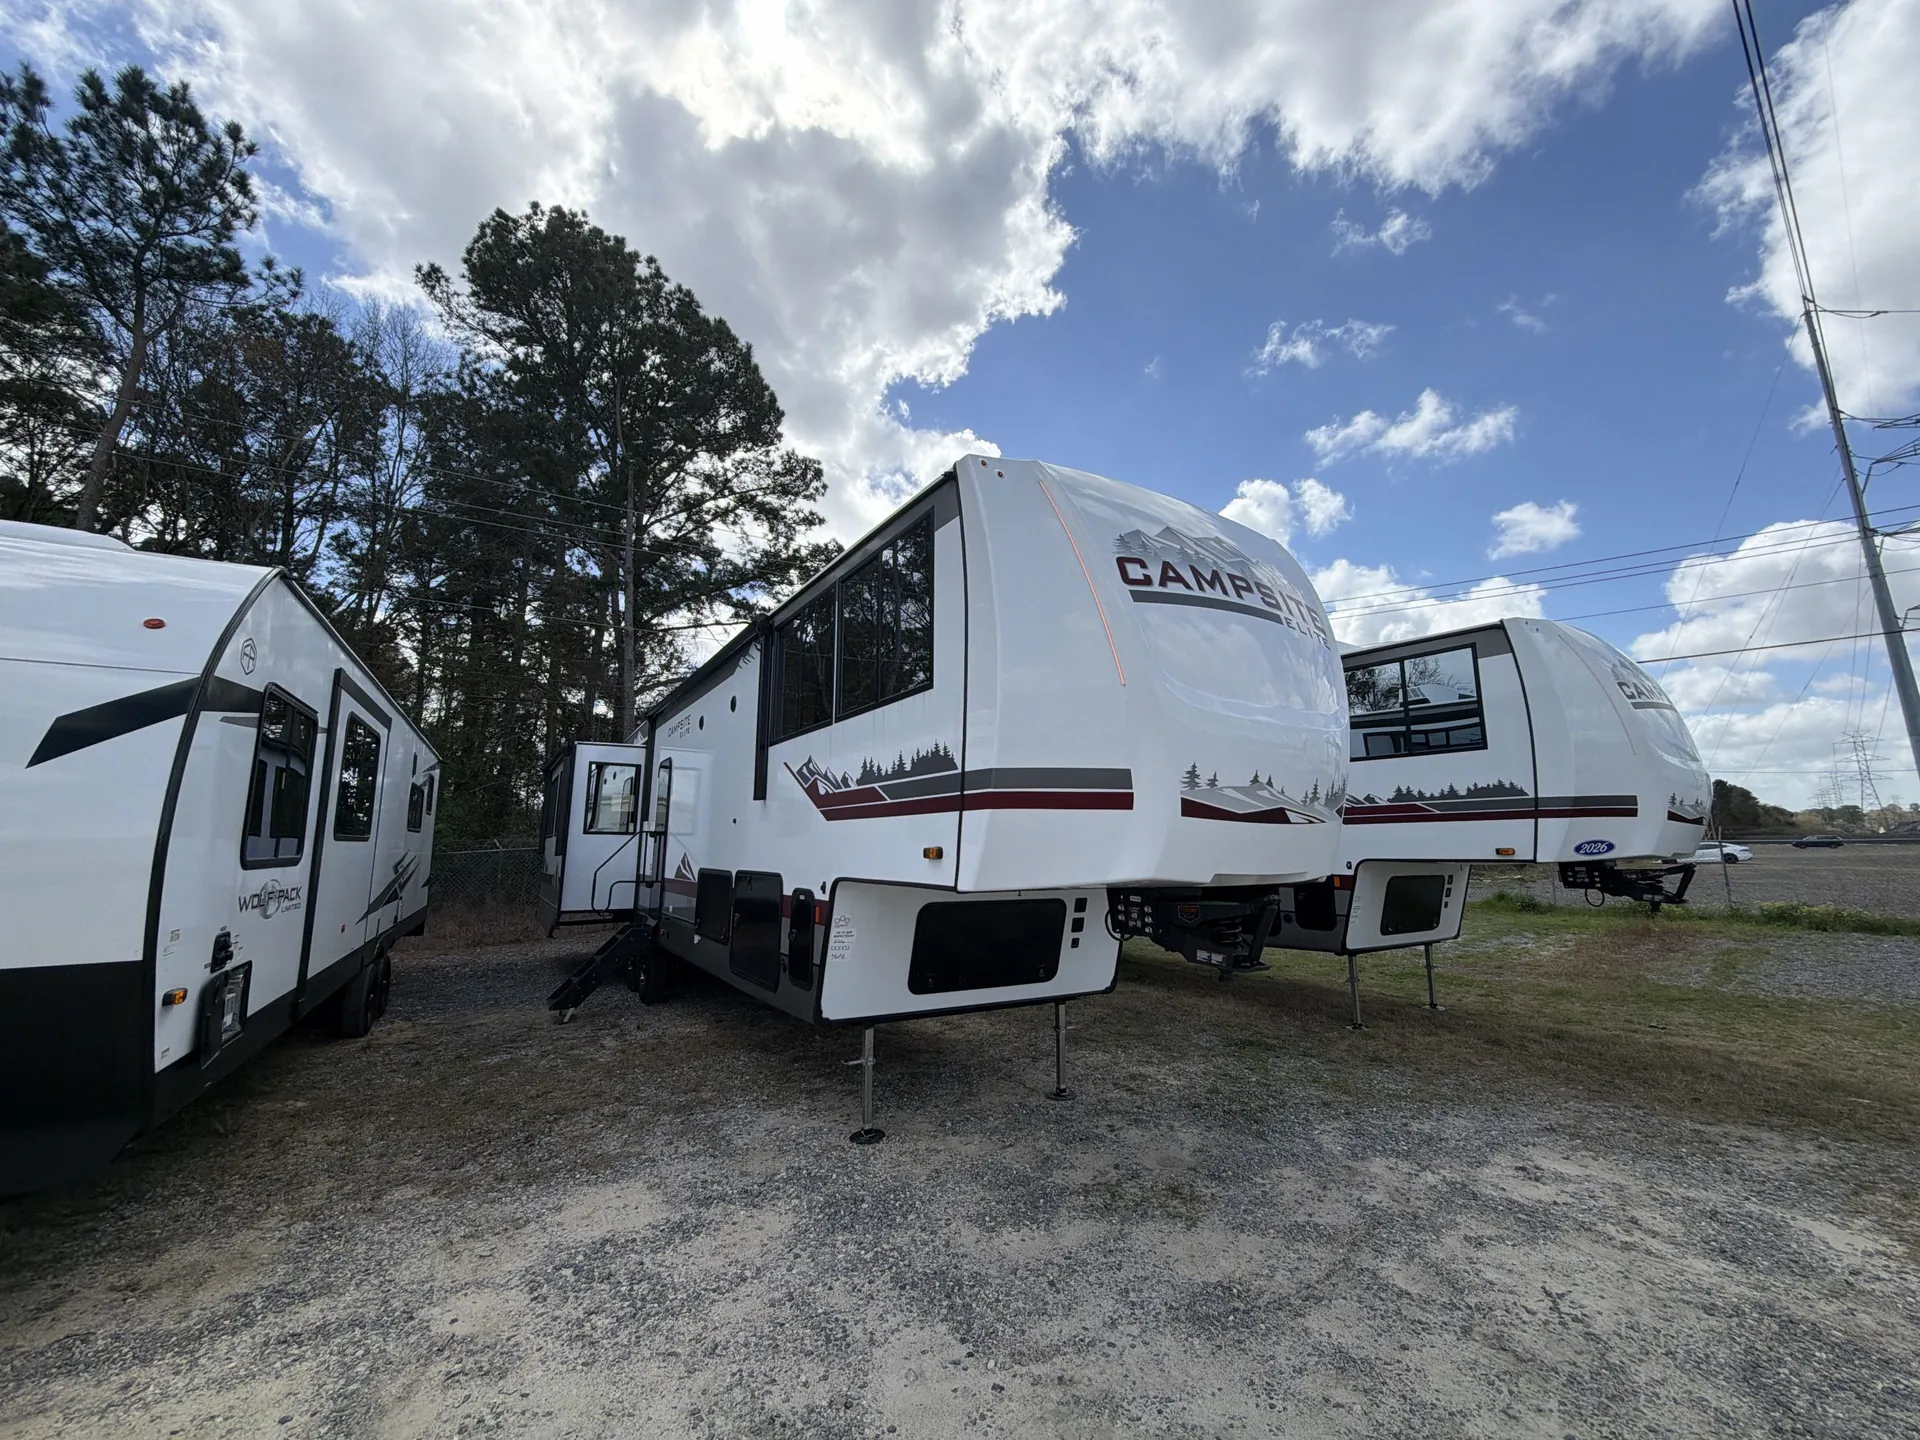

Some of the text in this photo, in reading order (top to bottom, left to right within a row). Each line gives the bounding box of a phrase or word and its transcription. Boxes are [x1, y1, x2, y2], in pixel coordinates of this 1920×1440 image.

[1116, 556, 1328, 638] CAMPSITE
[1284, 616, 1331, 650] ELITE
[1579, 842, 1609, 854] 2026
